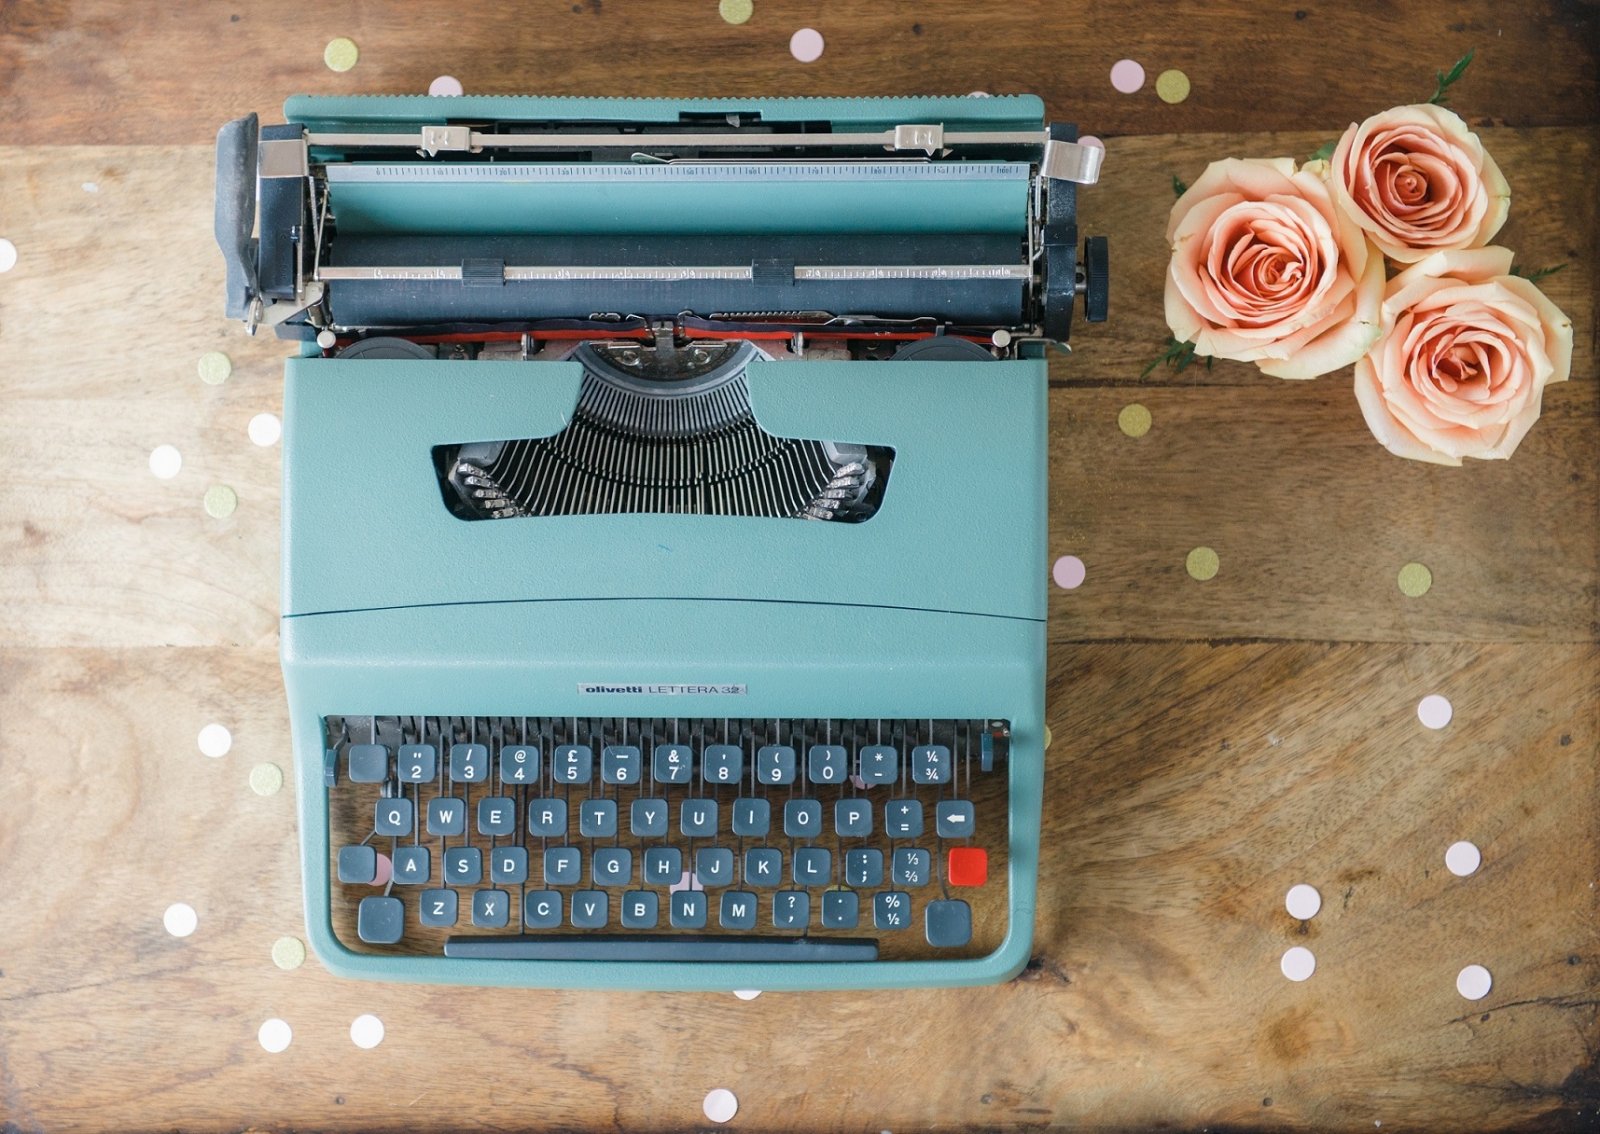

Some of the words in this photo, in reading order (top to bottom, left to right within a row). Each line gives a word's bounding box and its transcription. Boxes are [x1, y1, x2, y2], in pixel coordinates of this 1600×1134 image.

[585, 685, 643, 694] olivetti
[648, 685, 719, 694] LETTERA
[721, 685, 740, 694] 32
[514, 749, 527, 764] @
[567, 749, 578, 763] £
[668, 749, 680, 763] &
[411, 764, 422, 779] 2
[464, 765, 475, 779] 3
[514, 767, 525, 781] 4
[567, 766, 578, 780] 5
[616, 767, 627, 781] 6
[669, 766, 679, 780] 7
[718, 766, 729, 780] 8
[771, 768, 782, 782] 9
[900, 805, 909, 814] +
[388, 810, 401, 826] Q
[439, 810, 453, 824] W
[490, 810, 502, 824] E
[542, 810, 553, 824] R
[594, 811, 605, 826] T
[645, 811, 656, 825] Y
[693, 811, 705, 825] U
[797, 811, 809, 825] O
[849, 811, 860, 825] P
[900, 823, 909, 831] =
[405, 858, 417, 872] A
[457, 859, 469, 873] S
[503, 859, 515, 873] D
[557, 859, 569, 873] F
[607, 859, 619, 874] G
[658, 860, 670, 874] H
[710, 860, 720, 874] J
[758, 860, 769, 874] K
[807, 859, 818, 874] L
[432, 901, 445, 915] Z
[787, 896, 796, 908] ?
[885, 894, 900, 909] %
[484, 902, 495, 916] X
[537, 902, 549, 916] C
[584, 903, 596, 916] V
[634, 903, 646, 917] B
[683, 903, 695, 917] N
[732, 903, 746, 917] M
